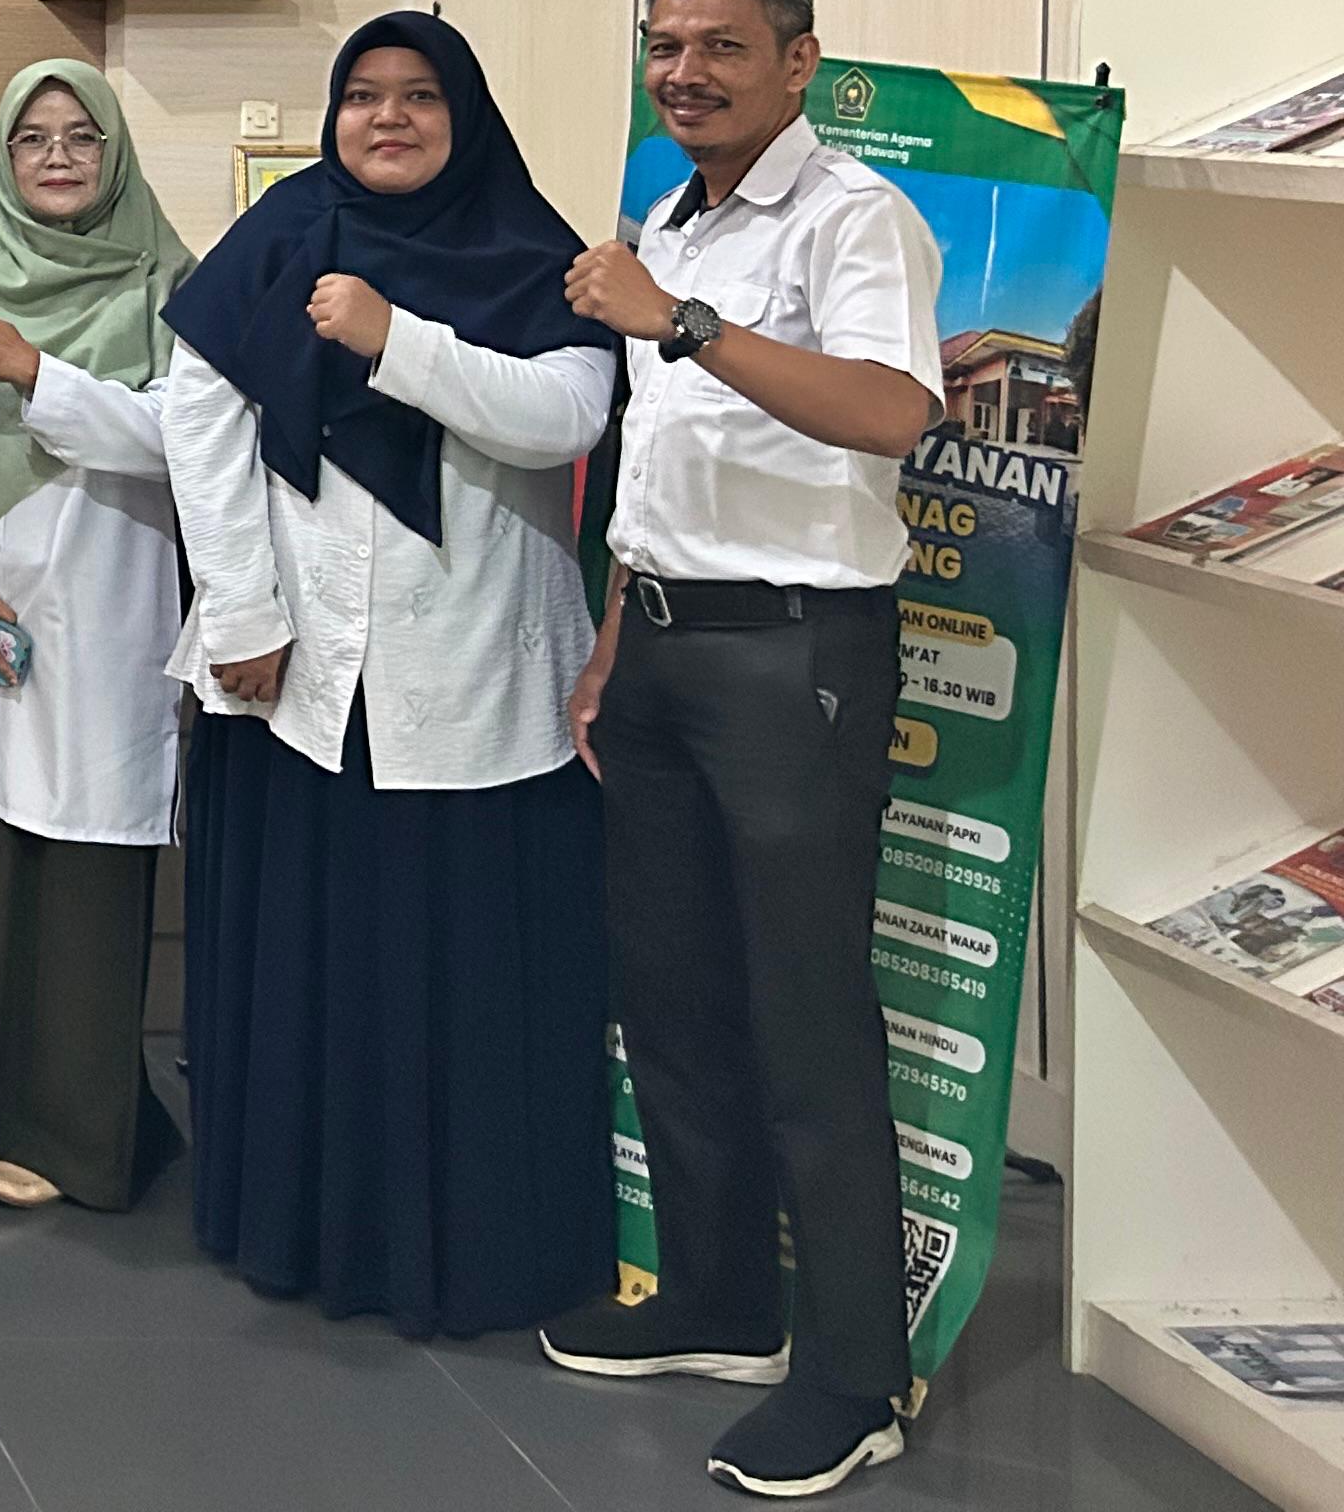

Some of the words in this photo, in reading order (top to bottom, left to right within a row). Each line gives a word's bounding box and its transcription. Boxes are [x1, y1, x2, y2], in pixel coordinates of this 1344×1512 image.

[818, 124, 889, 143] Kementerian
[891, 132, 933, 148] Agama
[864, 144, 910, 164] Bawang
[913, 435, 1062, 506] YANAN
[927, 614, 988, 639] ONLINE
[924, 676, 962, 699] 16.30
[966, 687, 997, 707] WIB
[885, 806, 944, 833] LAYANAN
[946, 824, 981, 844] PAPKI
[909, 920, 948, 941] ZAKAT
[950, 932, 992, 956] WAKAF
[918, 1031, 959, 1054] HINDU
